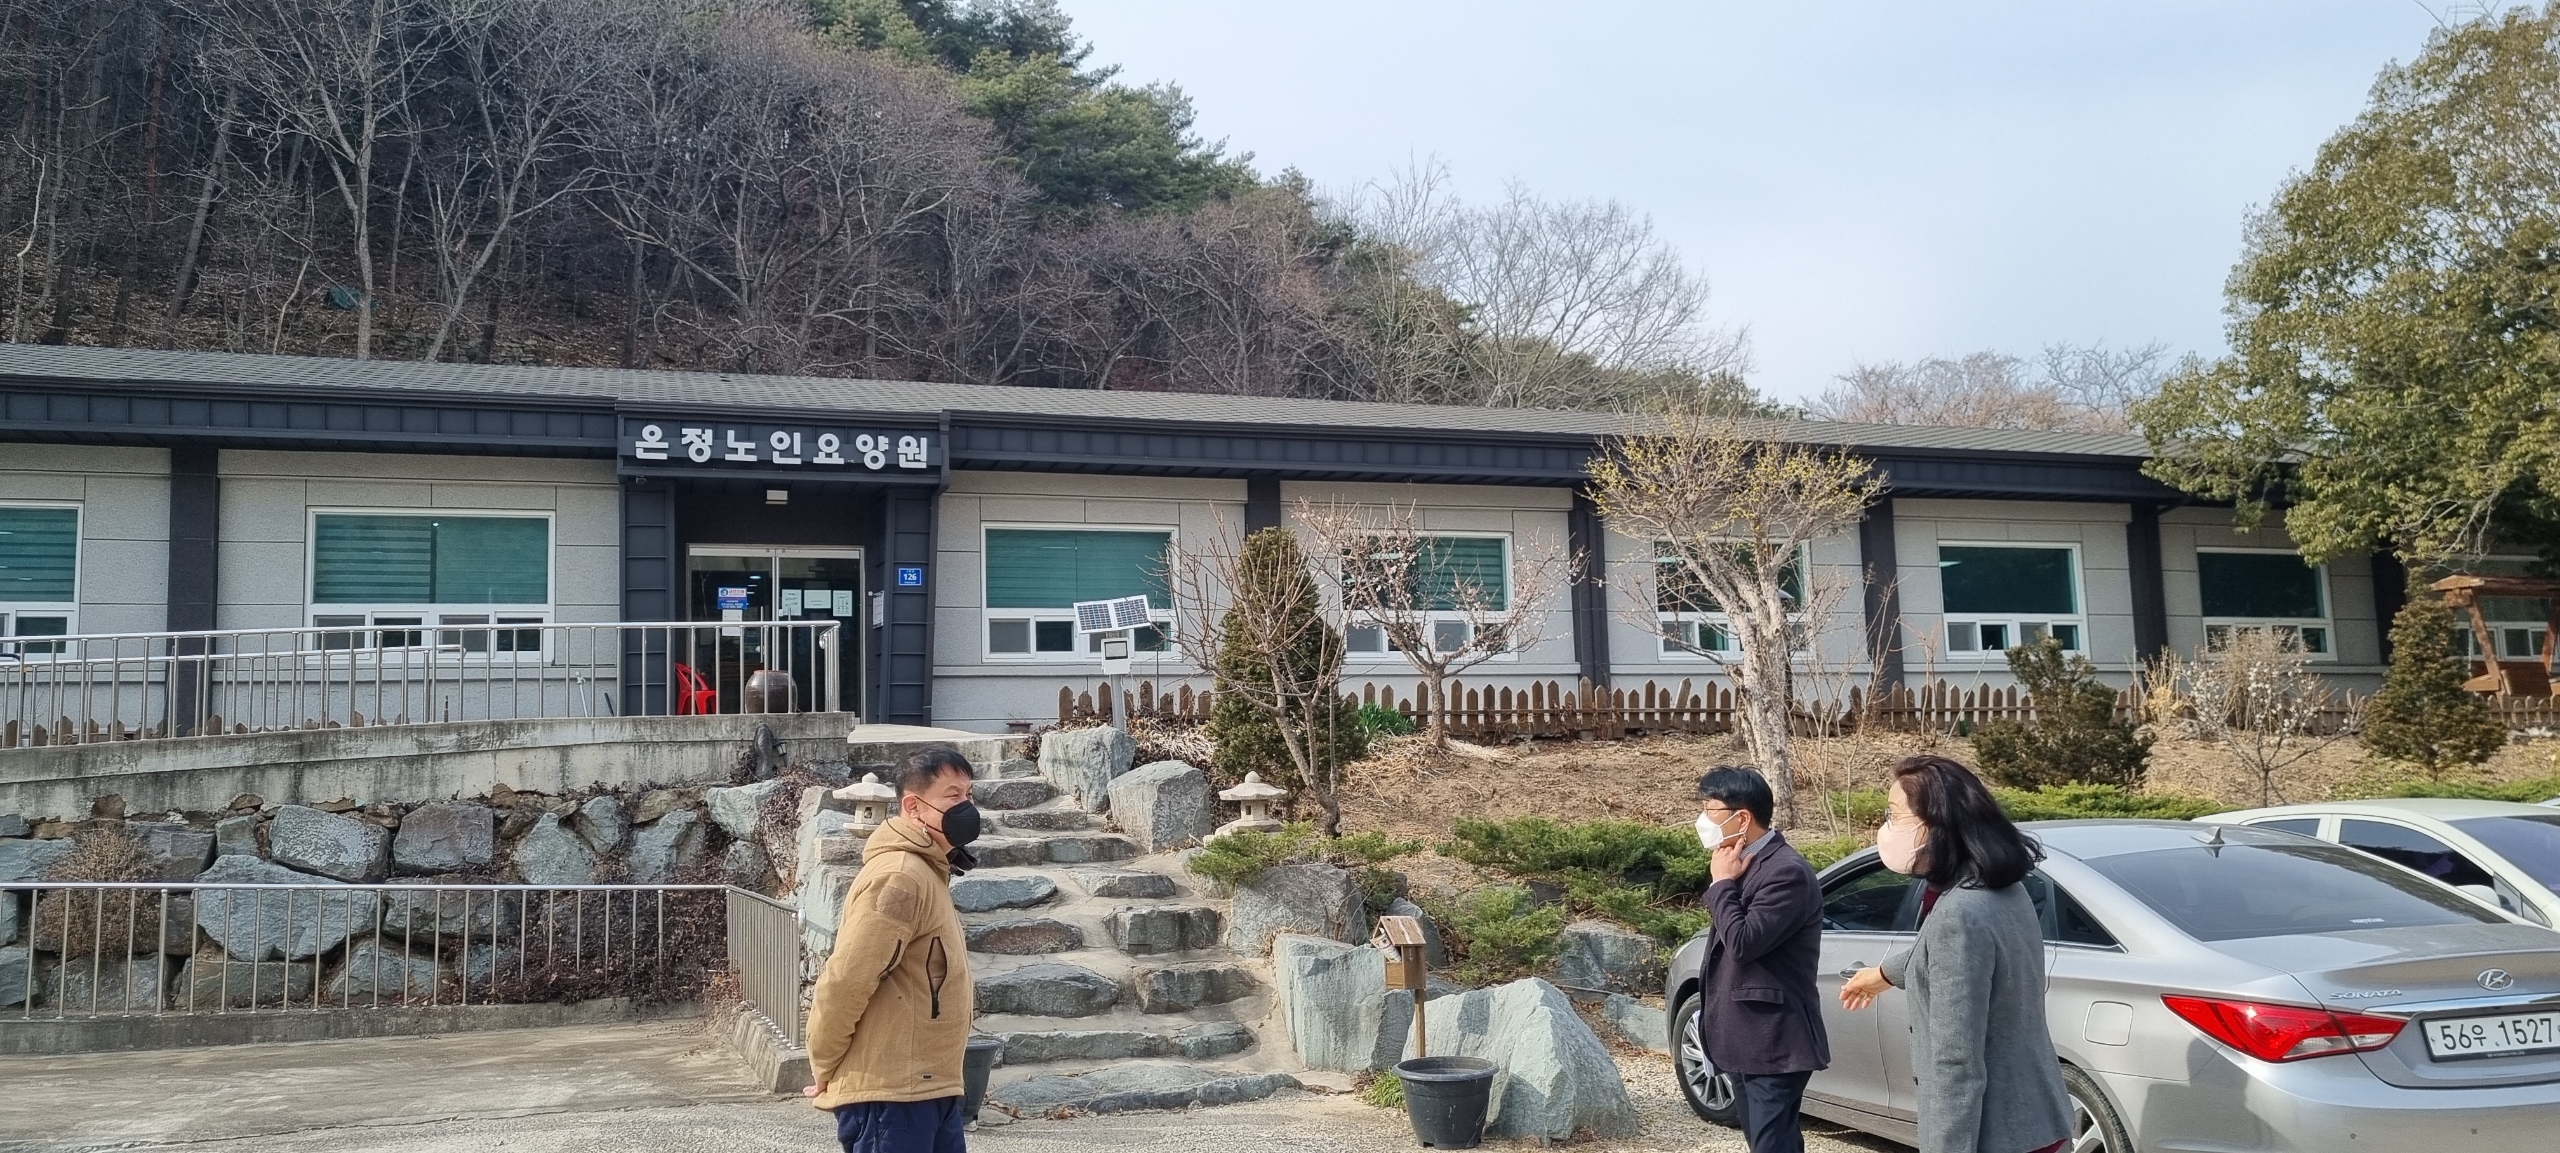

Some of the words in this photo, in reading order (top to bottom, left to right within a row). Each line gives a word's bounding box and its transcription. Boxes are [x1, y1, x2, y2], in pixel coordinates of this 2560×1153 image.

[635, 424, 928, 470] 은정노인요양원
[903, 573, 917, 581] 126
[2329, 989, 2402, 1000] SONATA
[2440, 1023, 2487, 1051] 56우
[2498, 1018, 2553, 1047] 1527
